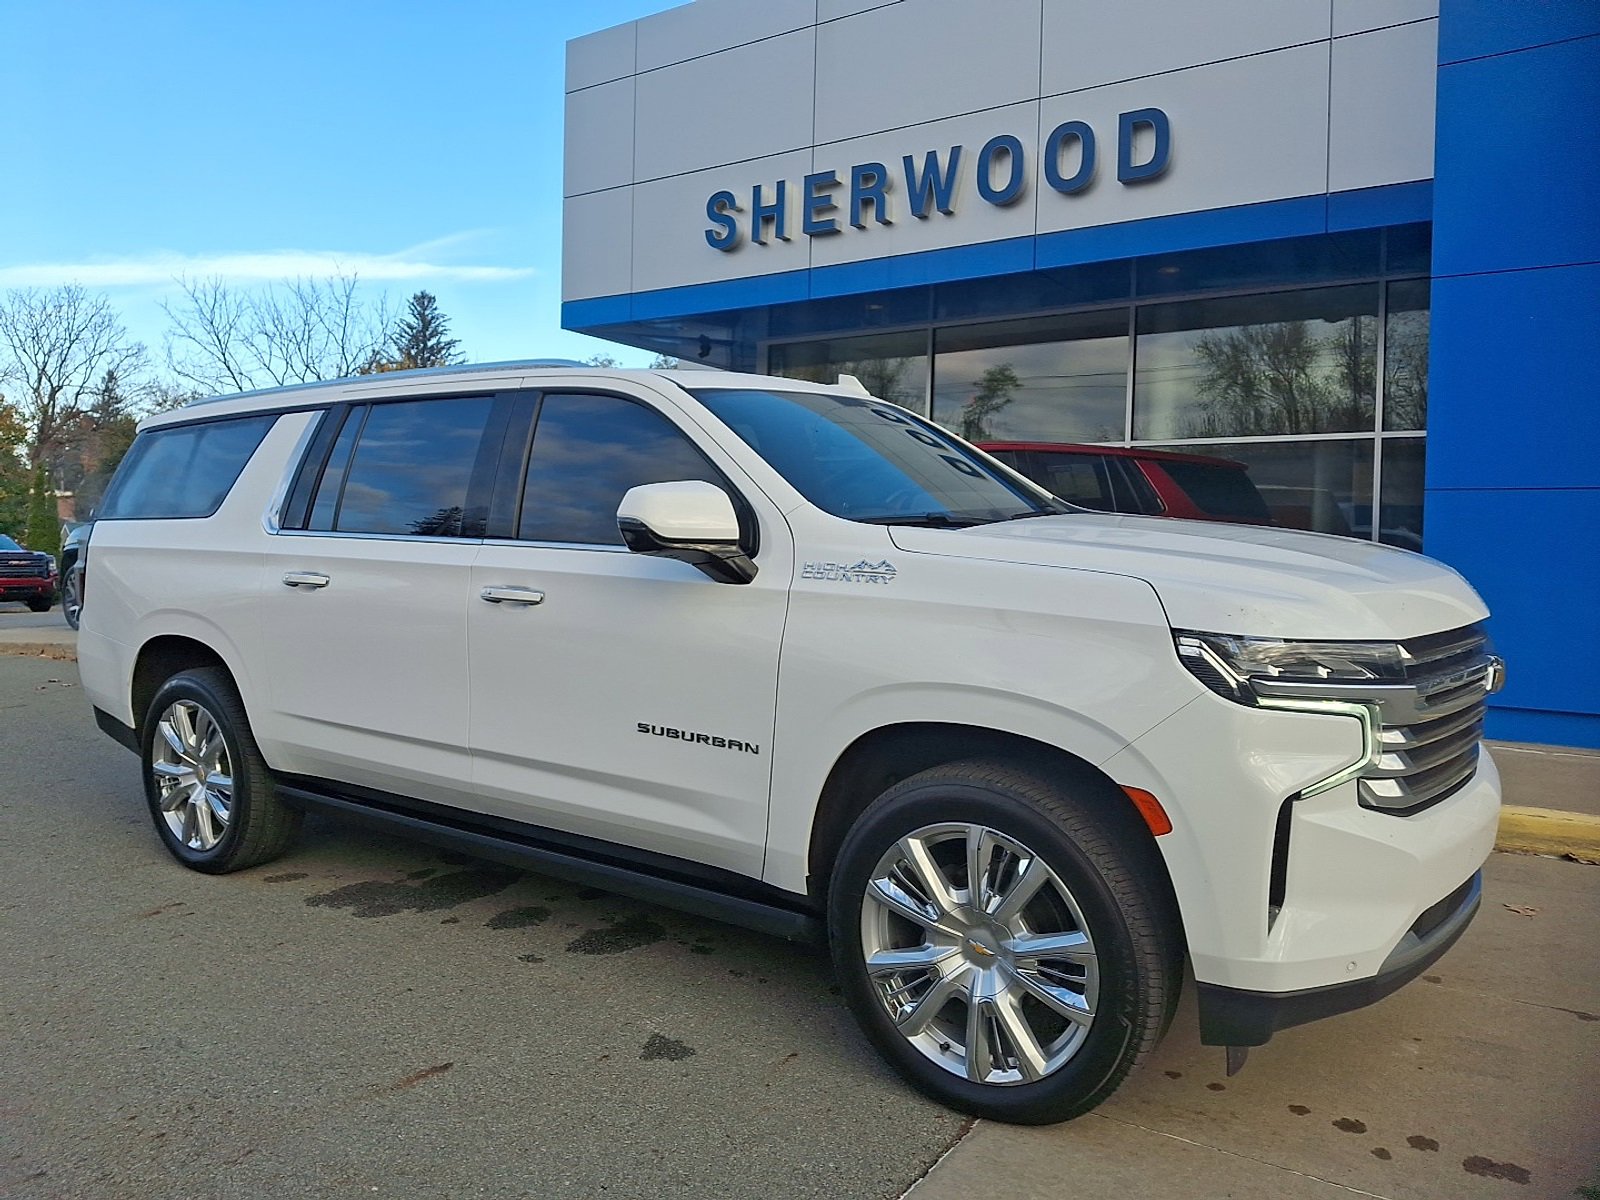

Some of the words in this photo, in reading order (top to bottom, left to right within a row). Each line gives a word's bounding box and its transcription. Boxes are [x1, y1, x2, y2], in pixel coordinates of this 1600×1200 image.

[705, 107, 1171, 251] SHERWOOD
[801, 571, 896, 584] COUNTRY
[803, 561, 849, 572] HIGH
[637, 722, 760, 755] SUBURBAN
